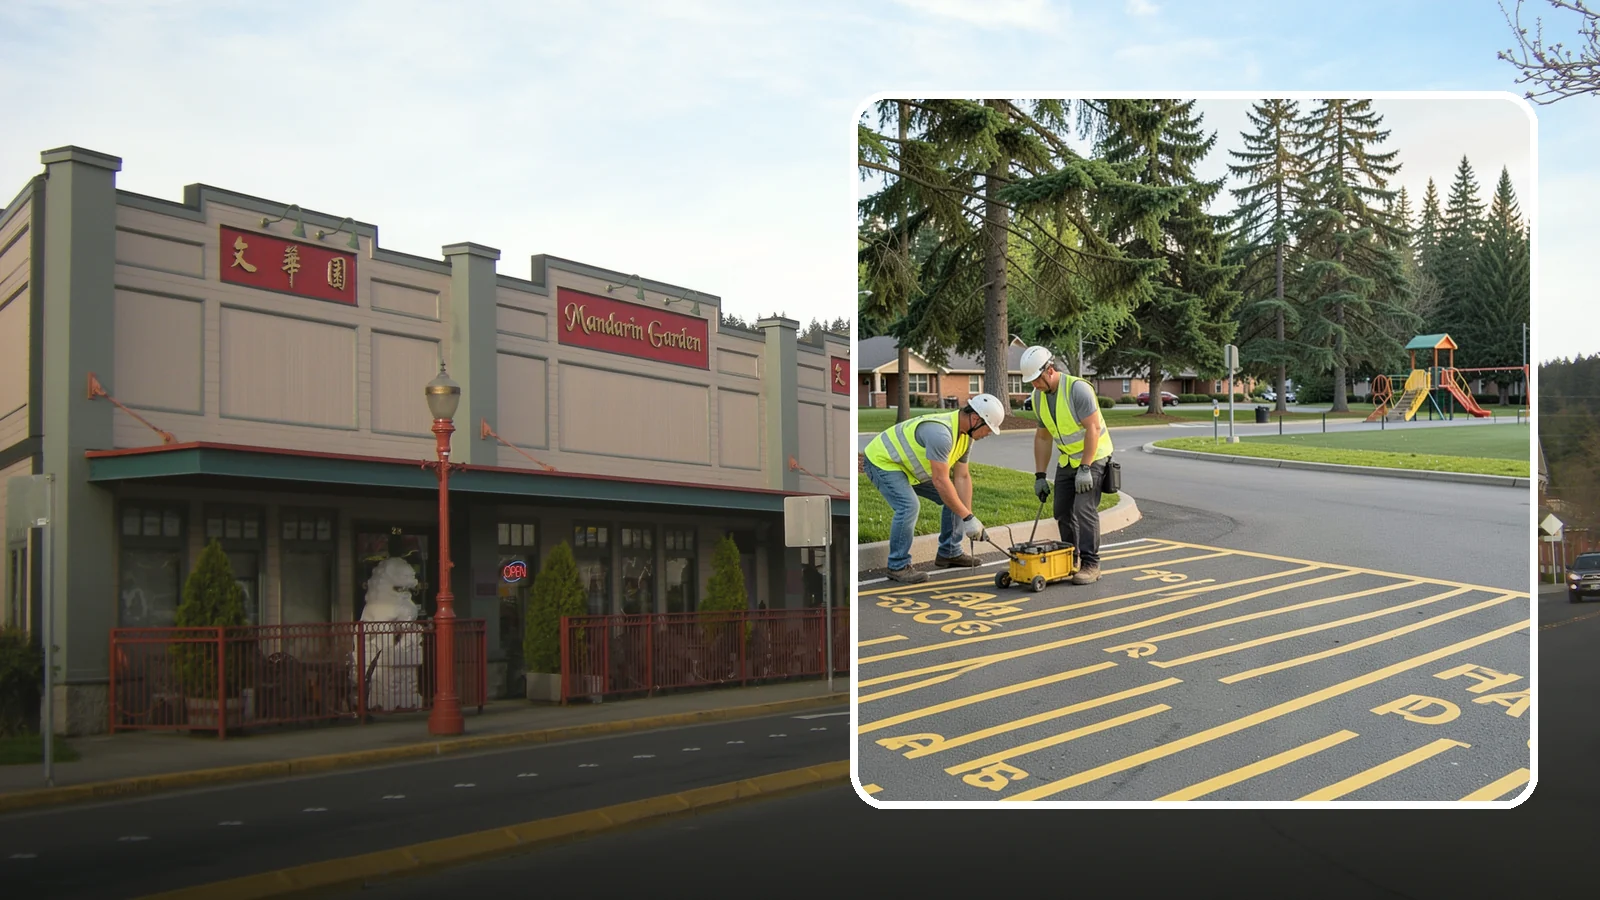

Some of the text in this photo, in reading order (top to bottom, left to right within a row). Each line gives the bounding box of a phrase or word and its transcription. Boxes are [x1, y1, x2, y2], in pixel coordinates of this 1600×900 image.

[231, 235, 346, 291] 文華園
[564, 302, 701, 352] Mandarin Garden
[503, 565, 527, 578] OPEN
